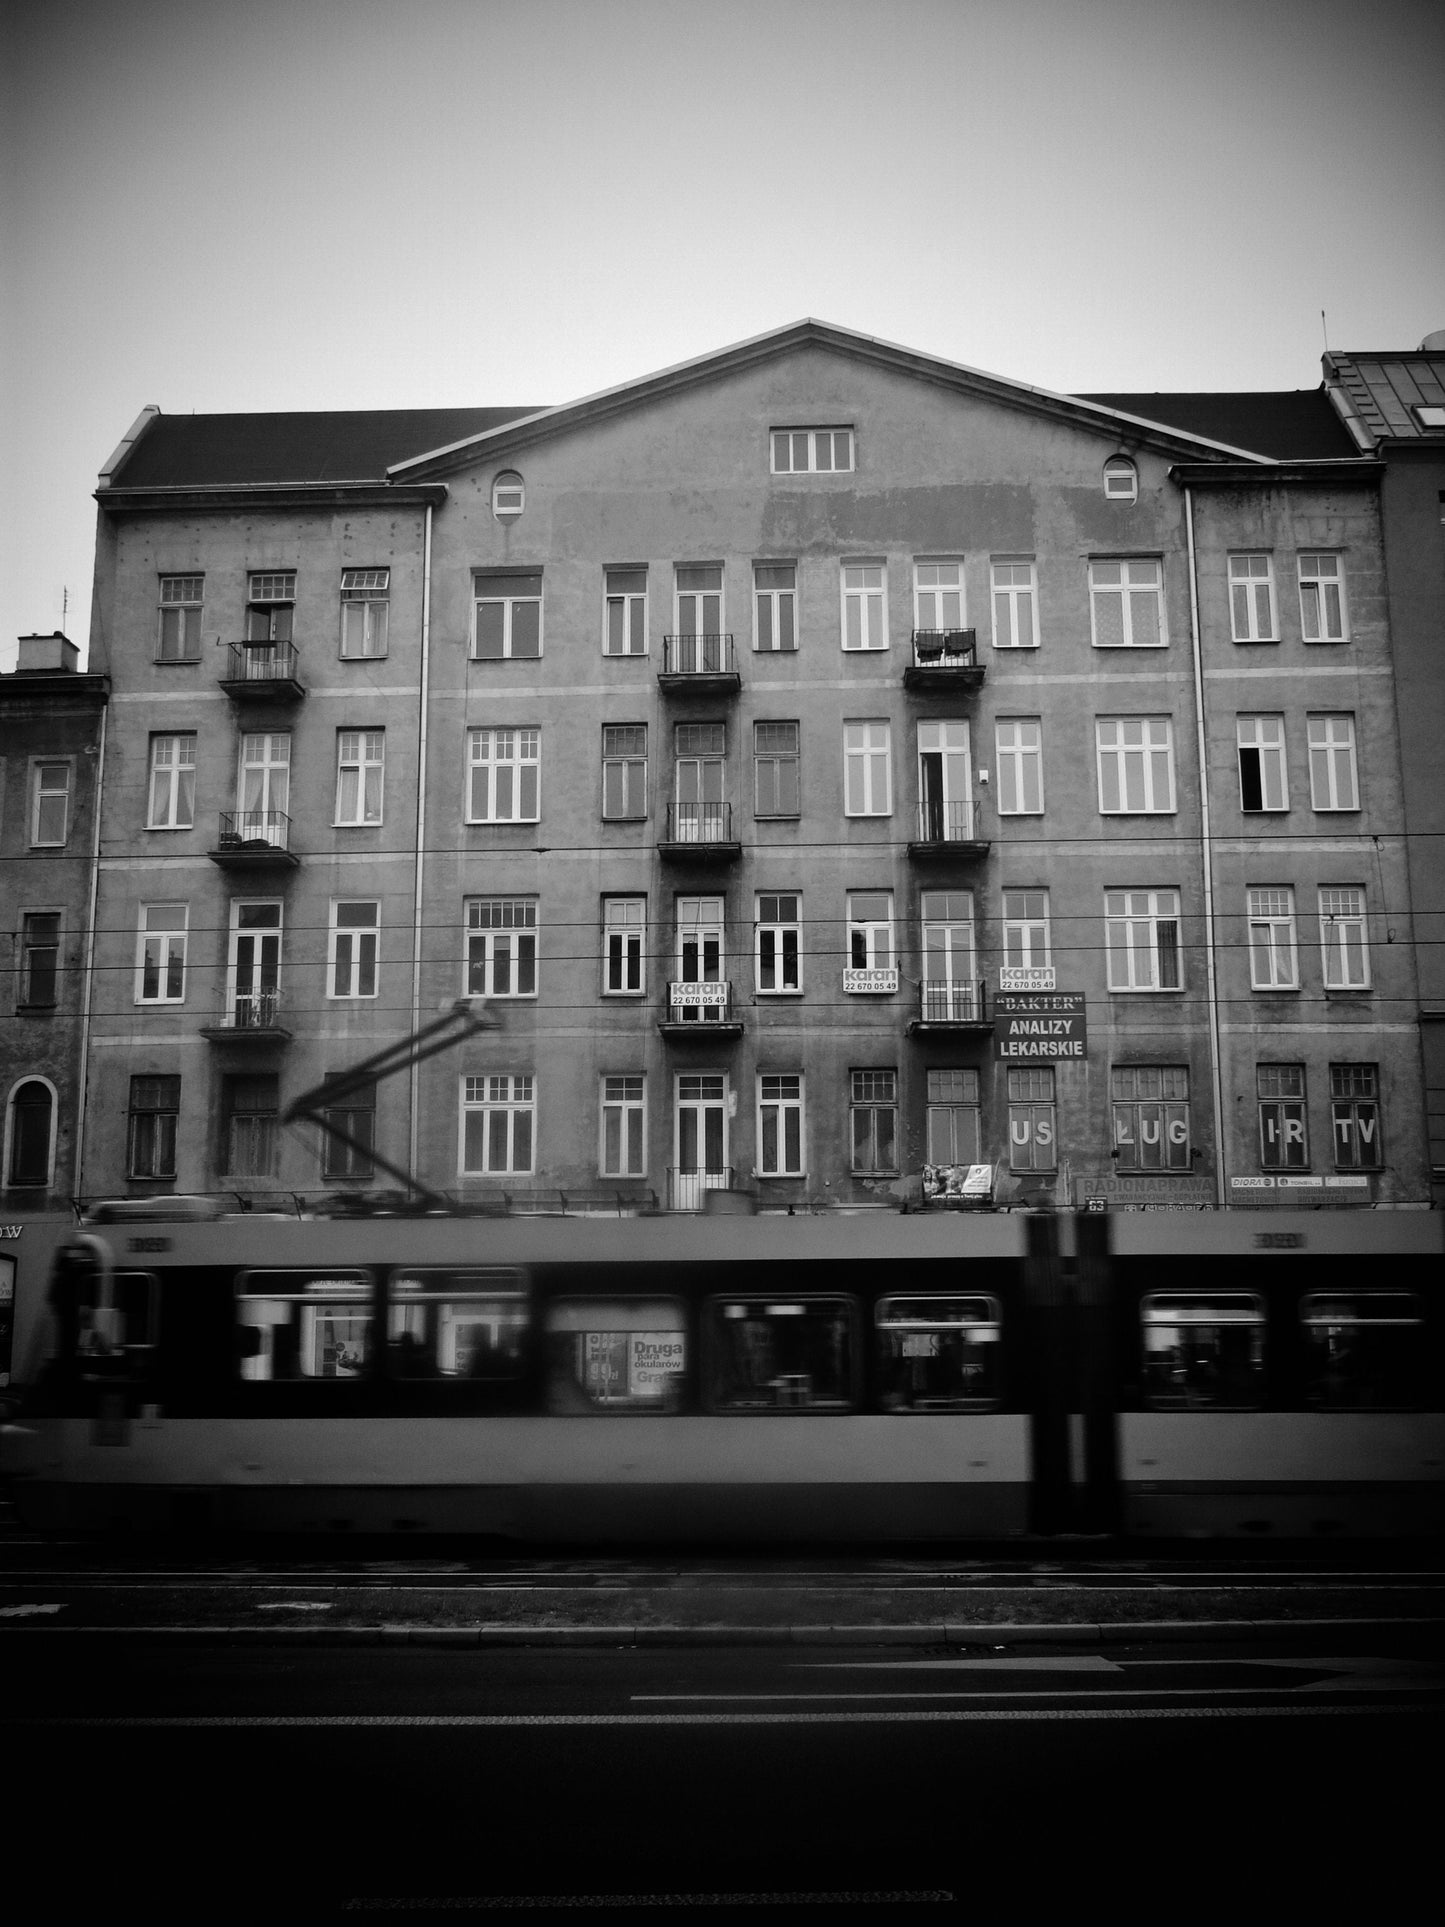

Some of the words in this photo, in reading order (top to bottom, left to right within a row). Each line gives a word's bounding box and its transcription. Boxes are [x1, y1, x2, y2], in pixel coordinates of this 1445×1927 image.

[844, 970, 896, 981] karan
[1001, 969, 1053, 980] karan
[673, 984, 725, 995] karan
[1002, 981, 1012, 989] 22
[1014, 981, 1029, 989] 670
[1031, 981, 1041, 989] 05
[1044, 981, 1054, 989] 49
[1009, 1020, 1072, 1034] ANALIZY
[1000, 1041, 1083, 1056] LEKARSKIE
[1084, 1179, 1214, 1192] RADIONAPRAWA
[1089, 1200, 1104, 1211] 63
[634, 1341, 683, 1357] Druga
[637, 1353, 660, 1361] para
[634, 1360, 681, 1368] okularów
